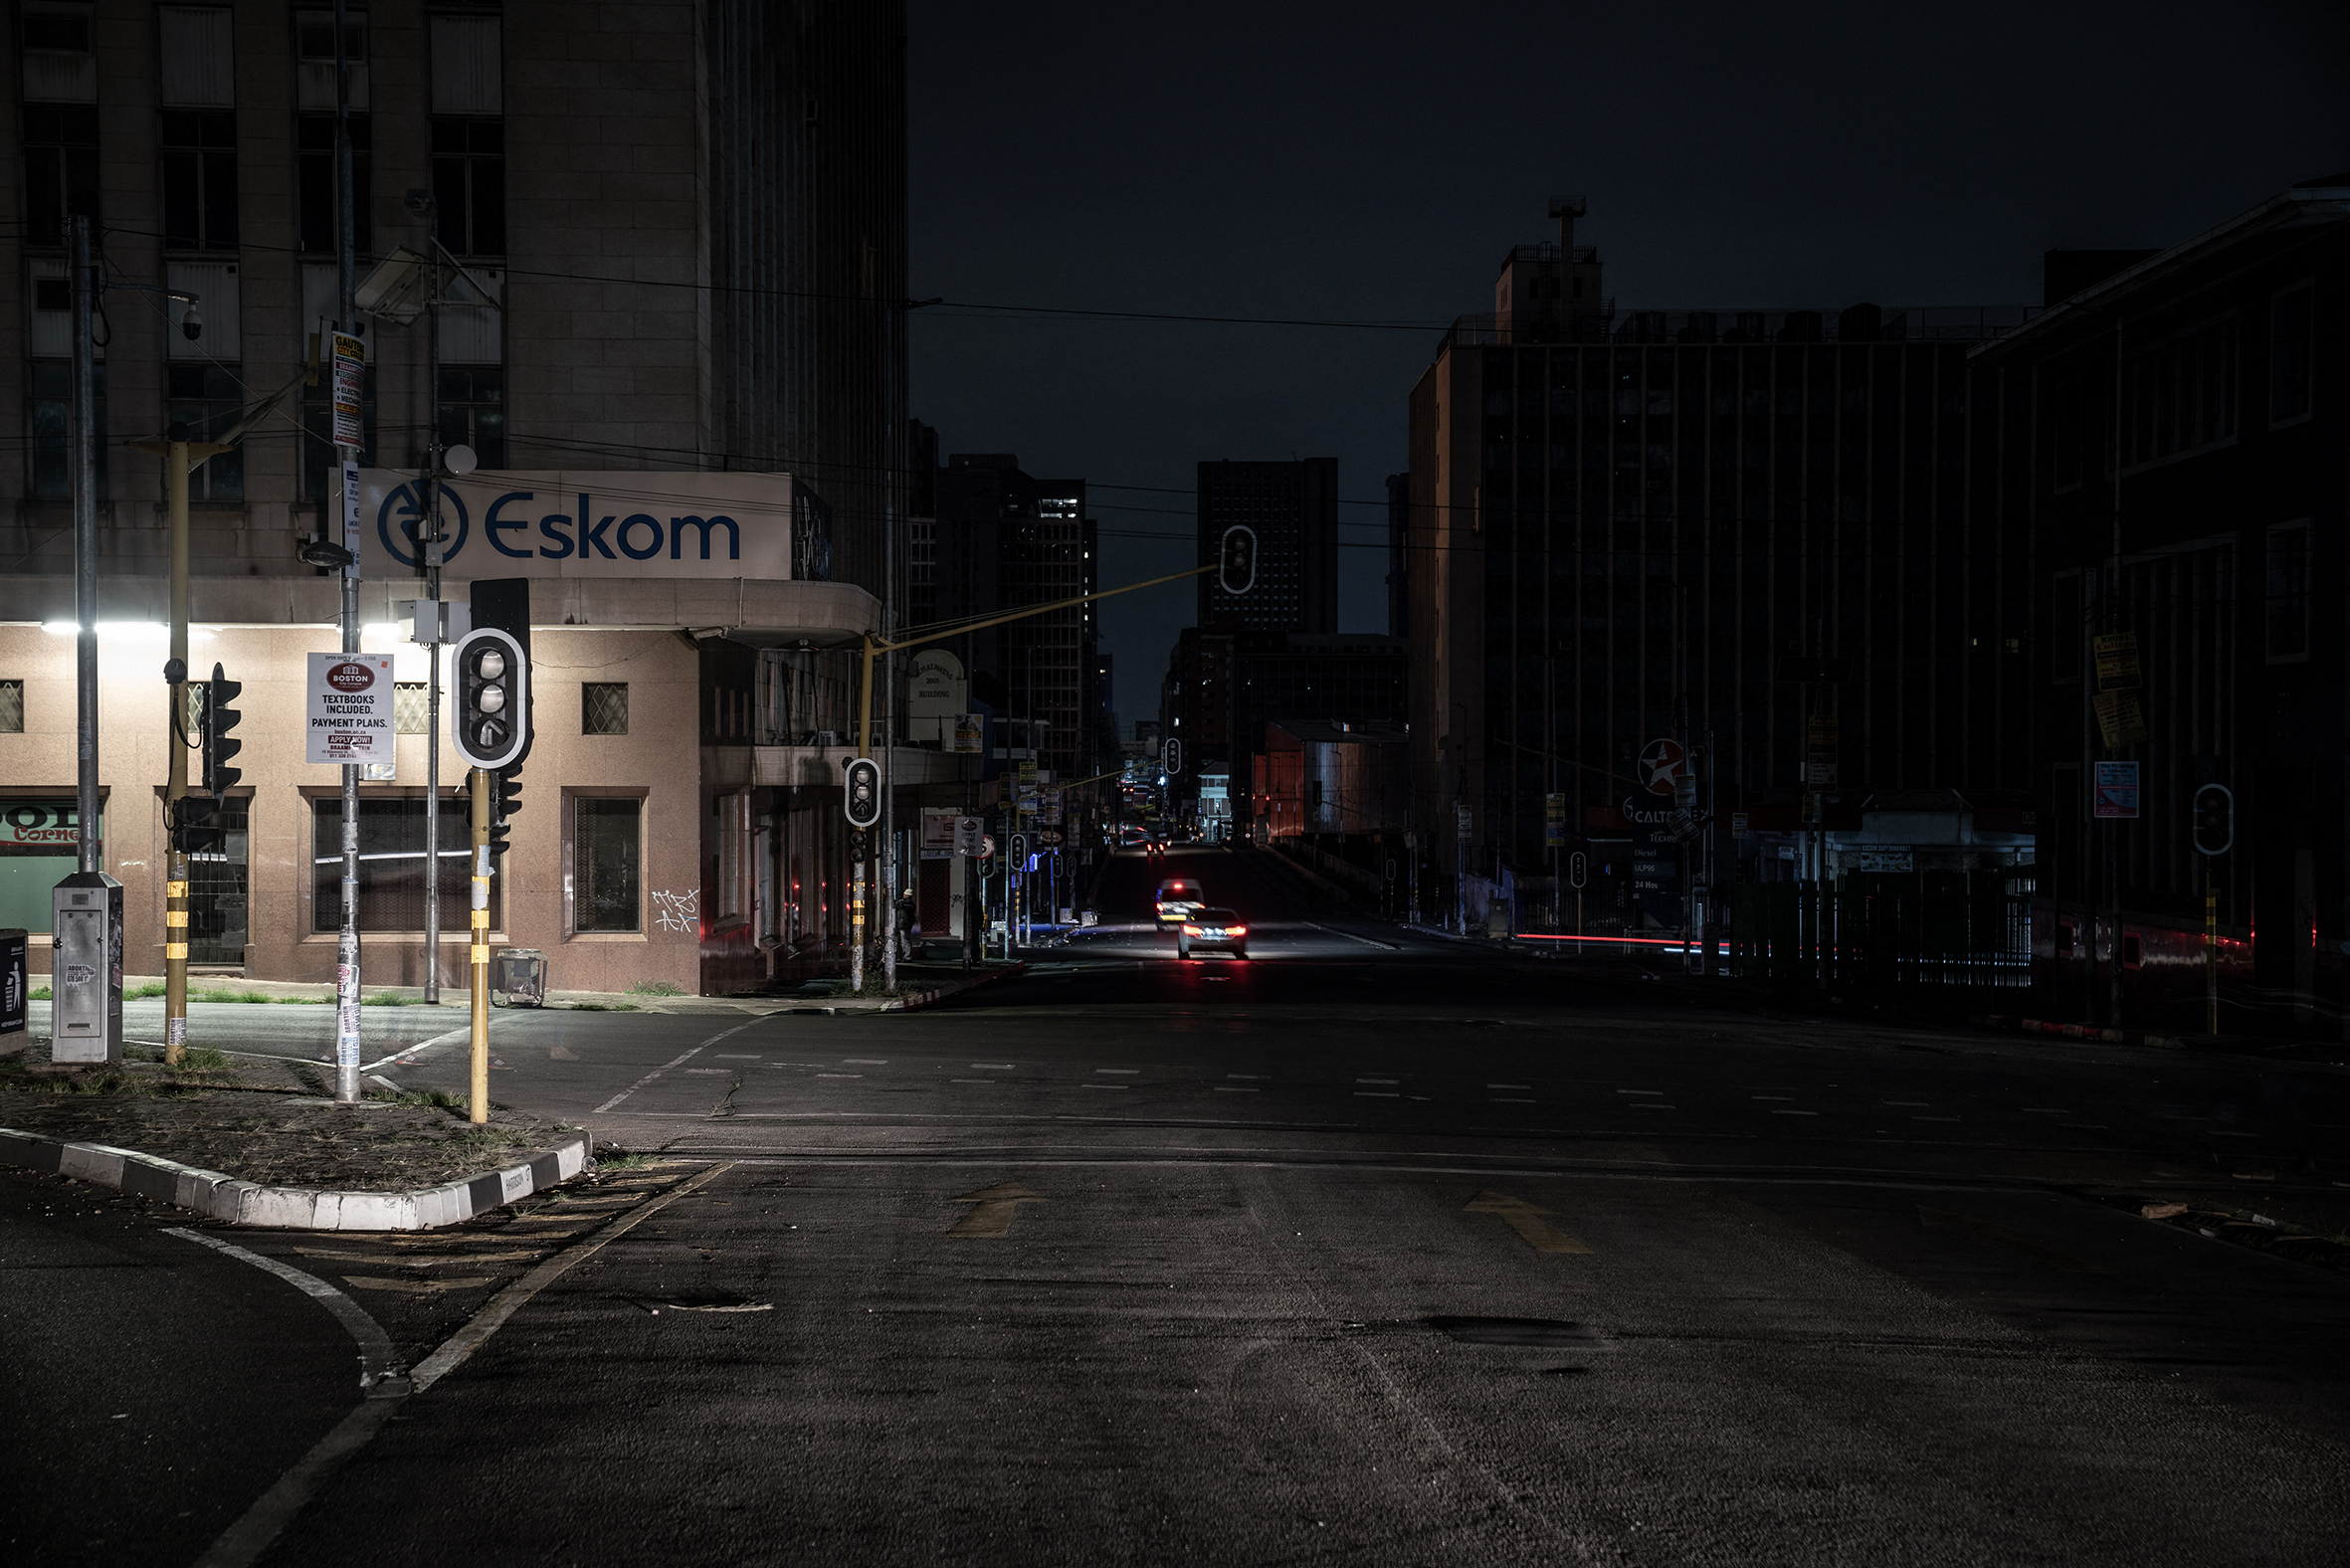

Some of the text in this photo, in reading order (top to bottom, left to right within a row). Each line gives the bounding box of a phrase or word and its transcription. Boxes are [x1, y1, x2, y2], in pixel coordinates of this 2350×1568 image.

[485, 491, 740, 560] Eskom
[322, 695, 375, 704] TEXTBOOKS
[327, 705, 373, 714] INCLUDED.
[312, 718, 387, 728] PAYMENT PLANS.
[14, 826, 79, 841] Corne
[343, 1006, 351, 1033] ABORTION
